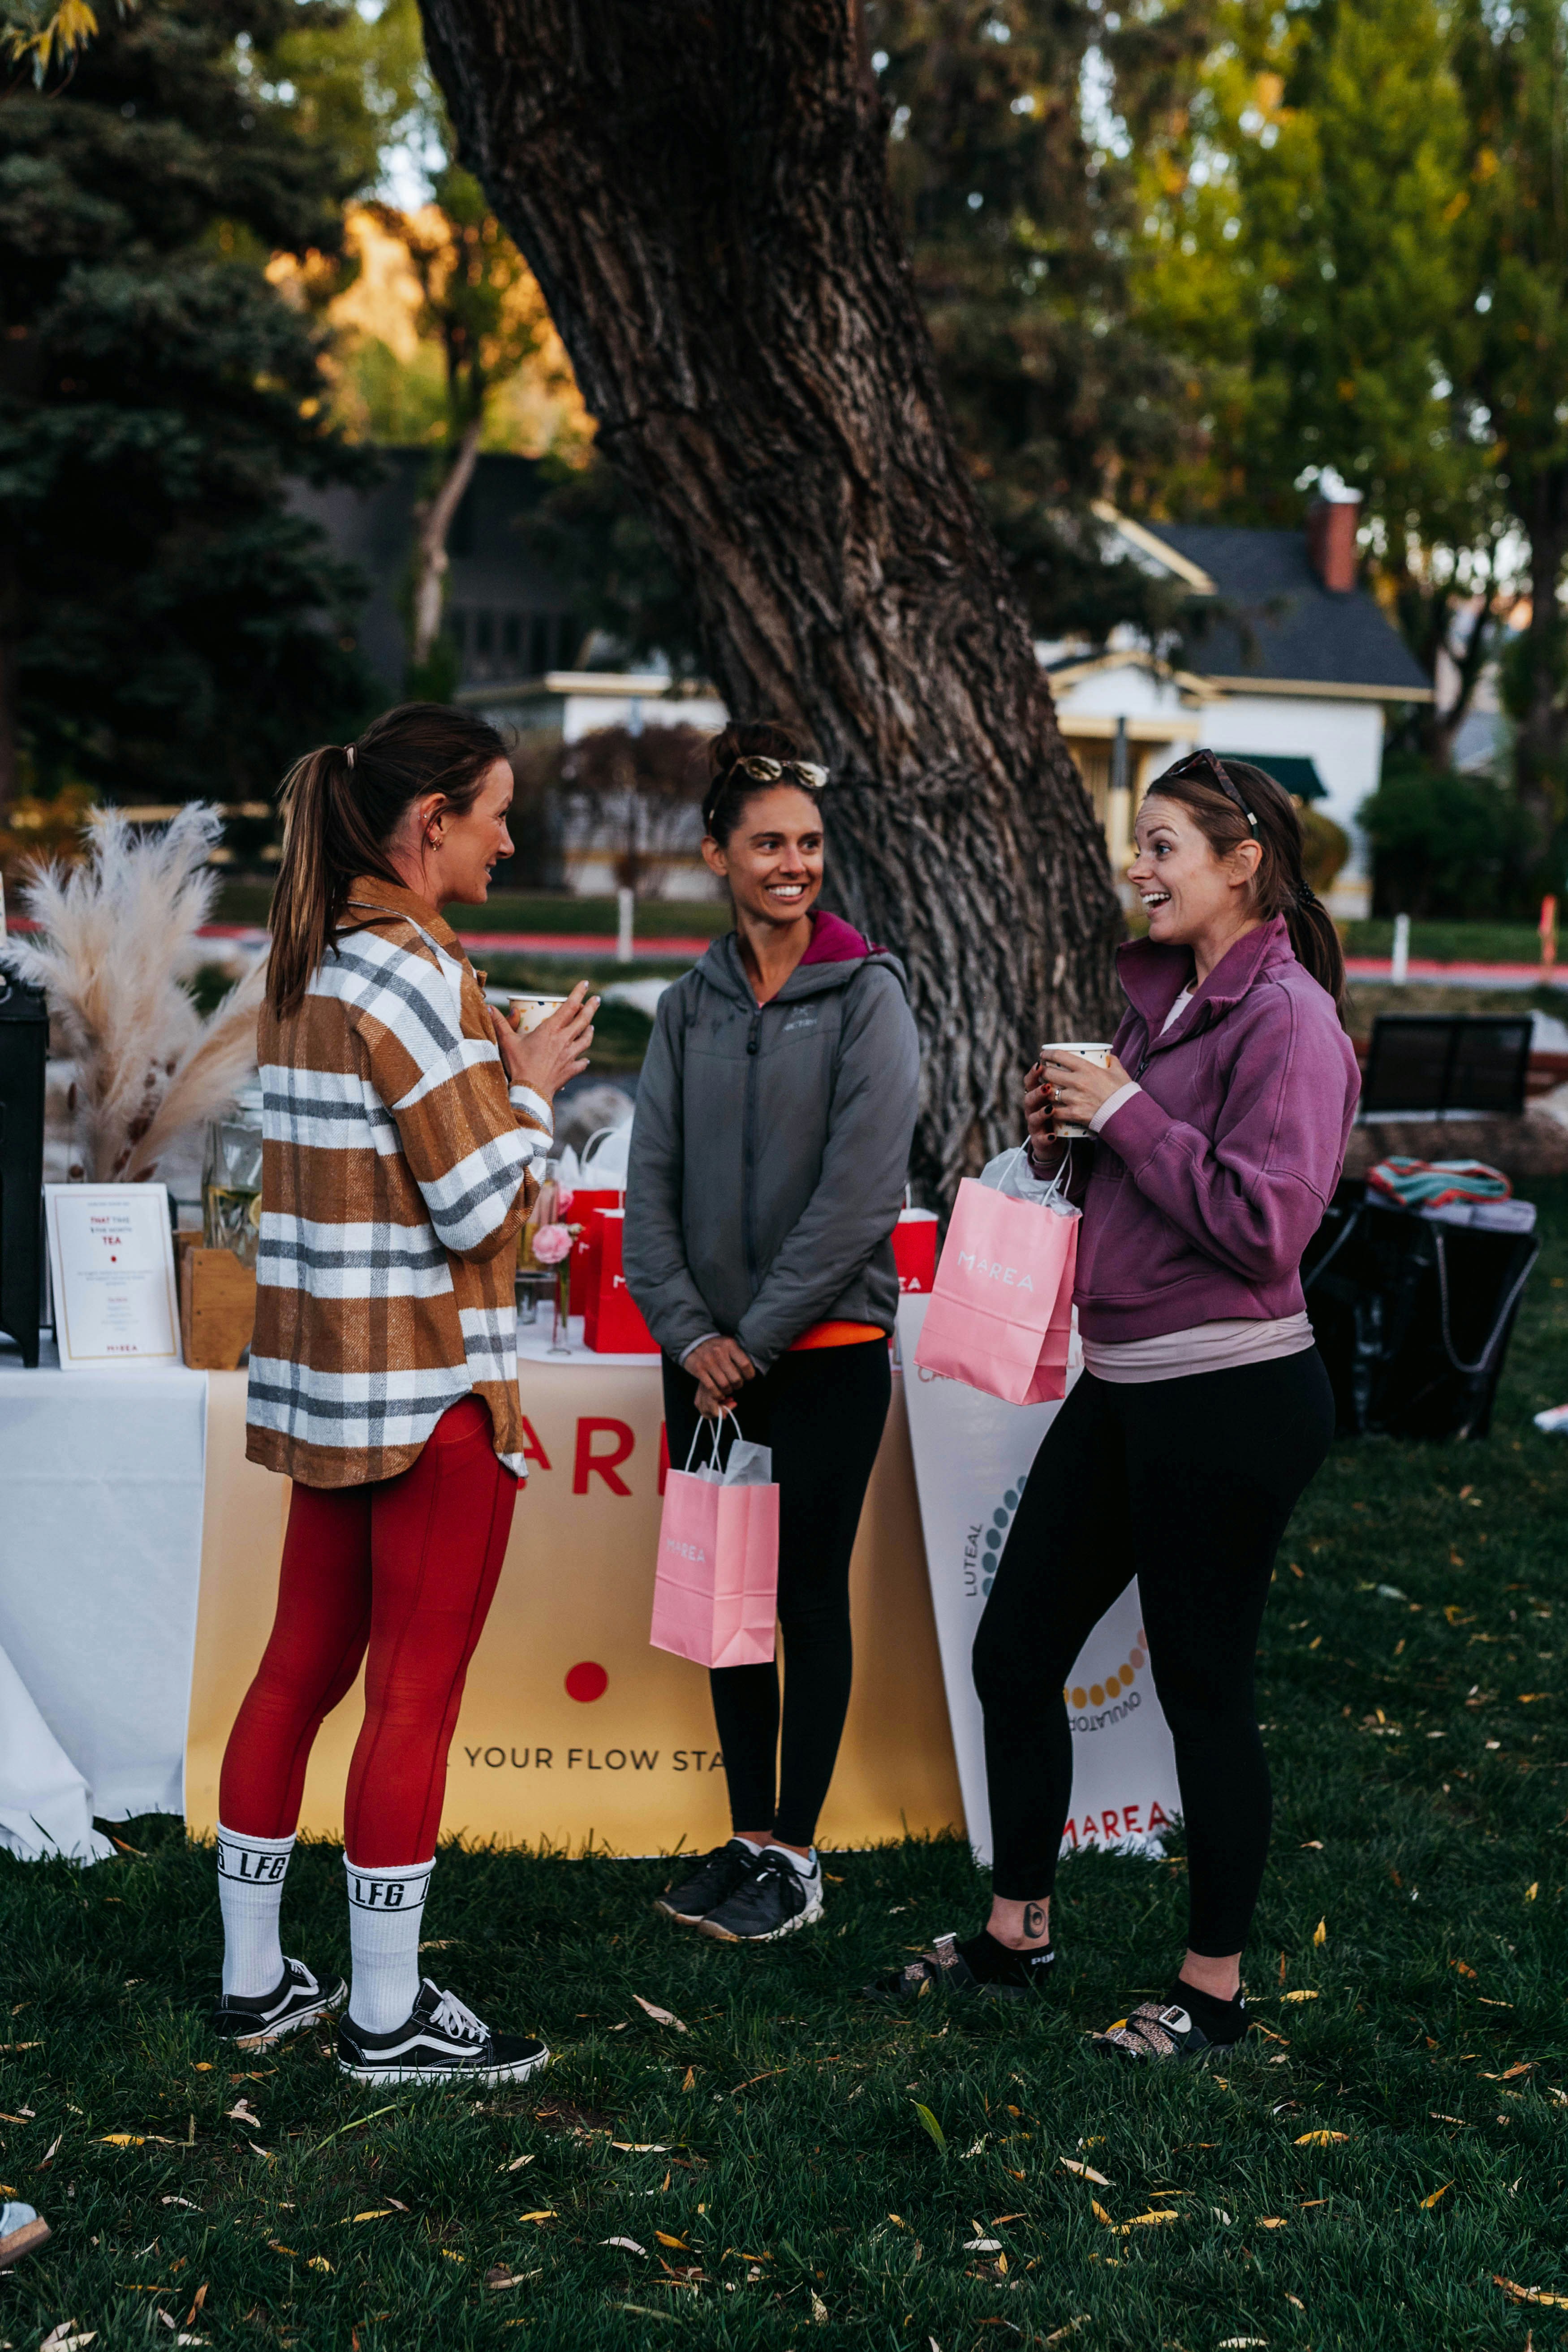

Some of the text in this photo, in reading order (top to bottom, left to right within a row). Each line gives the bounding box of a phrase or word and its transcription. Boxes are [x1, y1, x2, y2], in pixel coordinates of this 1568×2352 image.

[103, 1236, 121, 1245] TEA
[957, 1250, 1033, 1292] MAREA
[964, 1524, 983, 1596] LUTEAL
[465, 1747, 552, 1768] YOUR
[568, 1749, 659, 1770] FLOW
[240, 1852, 286, 1879] LFG
[355, 1878, 405, 1906] LFG
